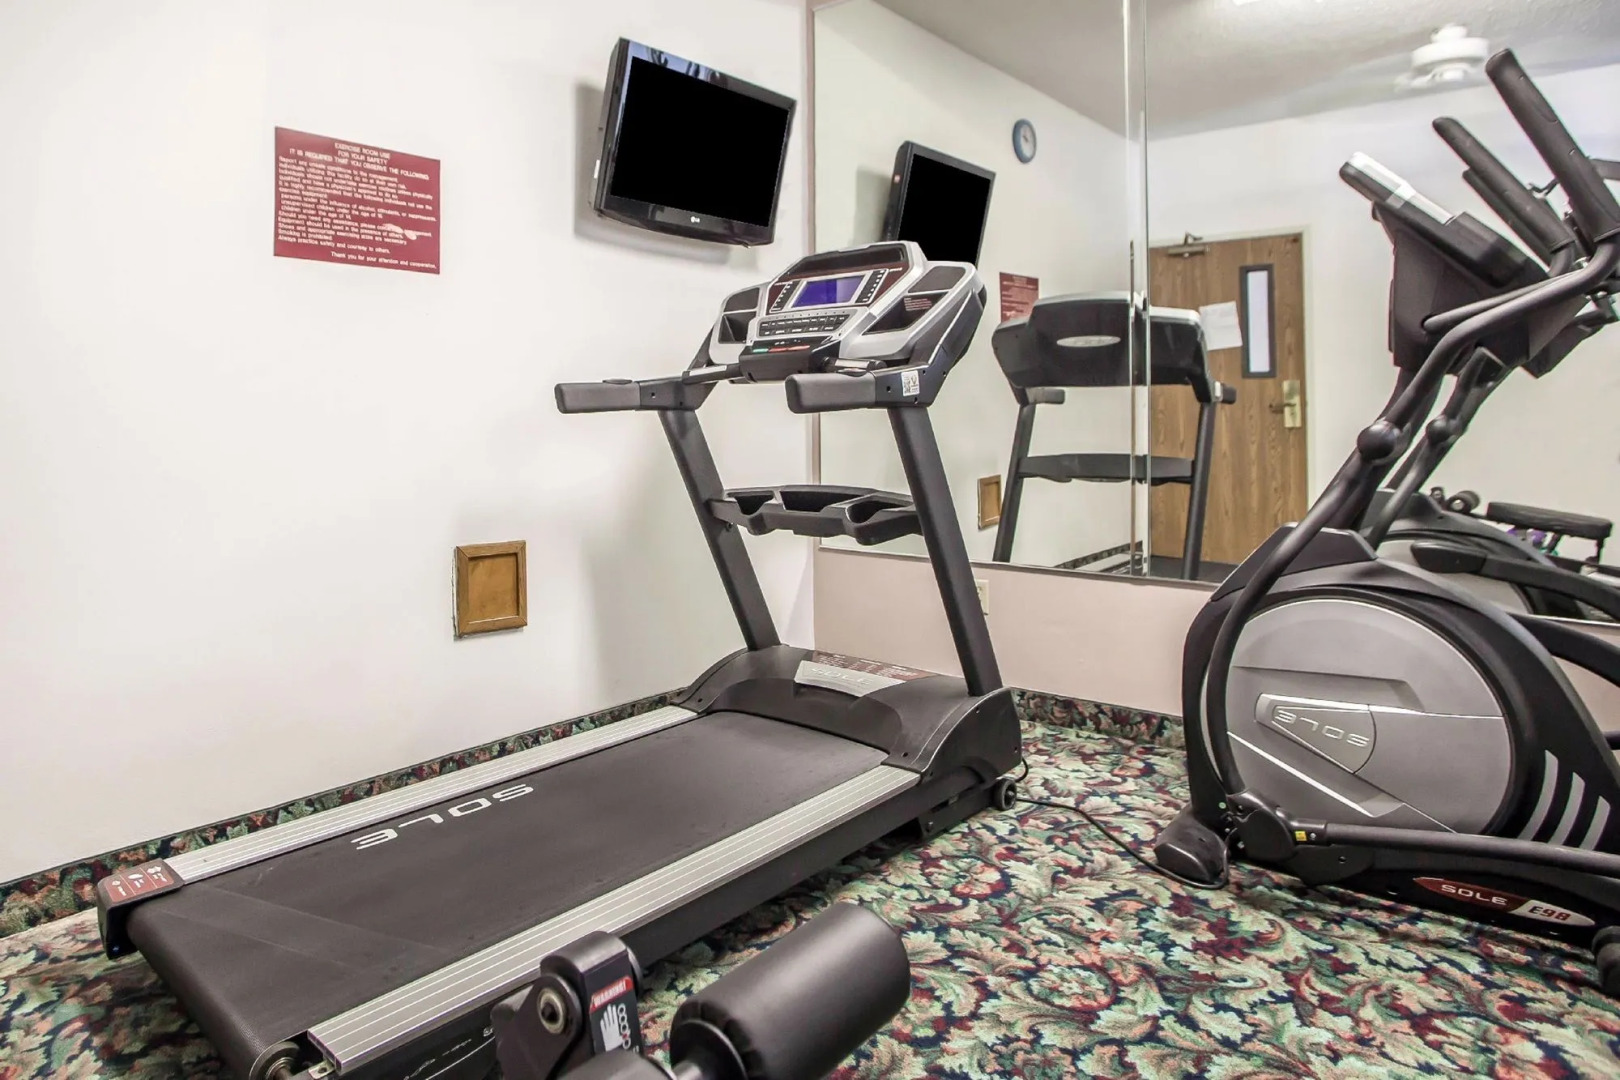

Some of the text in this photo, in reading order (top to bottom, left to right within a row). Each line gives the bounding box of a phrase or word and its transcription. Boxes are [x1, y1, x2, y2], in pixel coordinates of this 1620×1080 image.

[304, 151, 332, 161] REQUIRED
[362, 162, 386, 171] OBSERVE
[366, 156, 387, 164] SAFETY
[1274, 709, 1370, 748] SOLE
[350, 783, 534, 851] SOLE
[1440, 884, 1572, 921] SOLE E98
